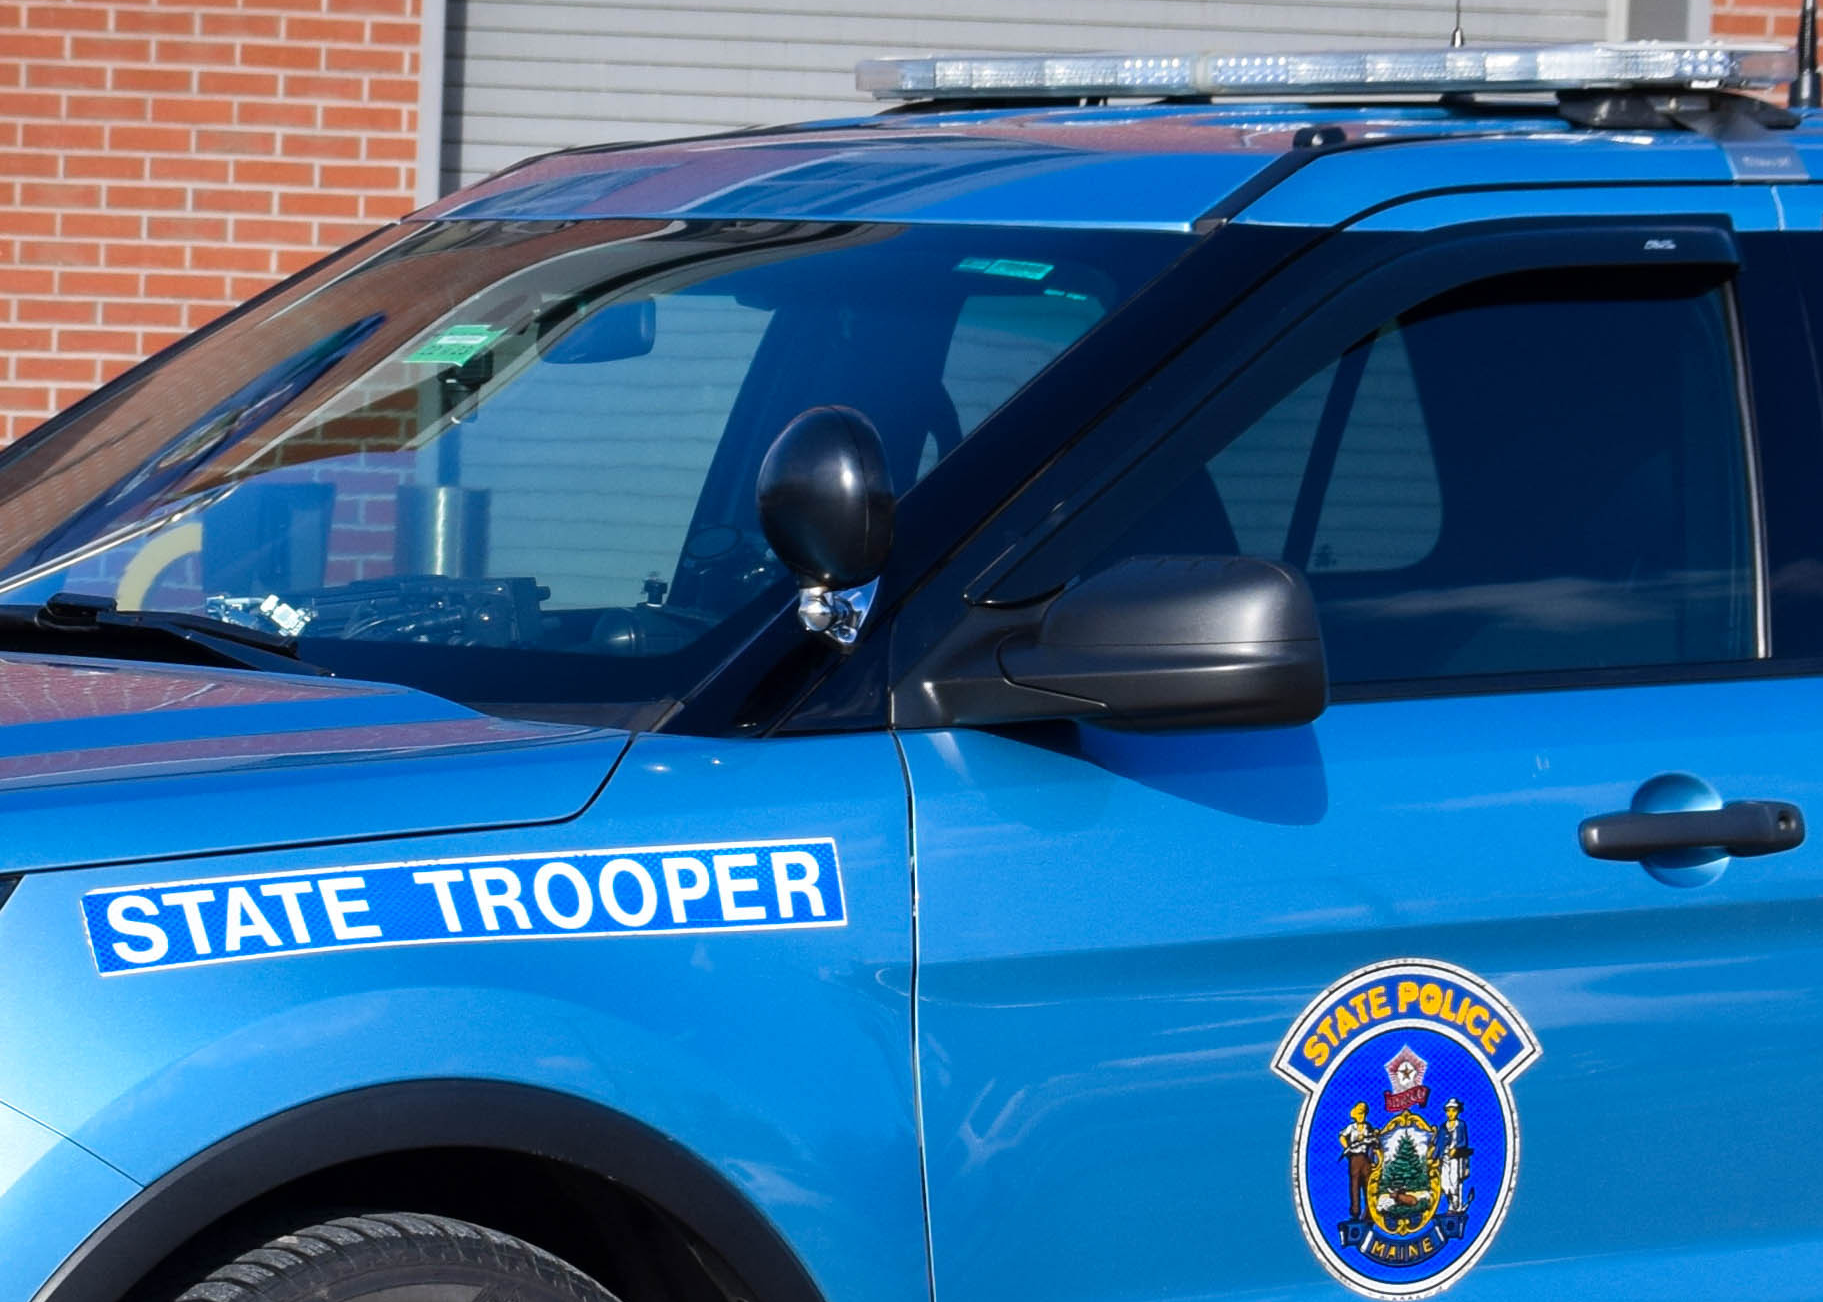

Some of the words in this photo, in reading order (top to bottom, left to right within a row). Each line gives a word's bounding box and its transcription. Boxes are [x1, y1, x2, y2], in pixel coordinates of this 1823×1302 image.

[105, 877, 384, 965] STATE
[413, 851, 828, 934] TROOPER
[1303, 985, 1392, 1068] STATE
[1397, 981, 1507, 1057] POLICE
[1371, 1235, 1435, 1260] MAINE
